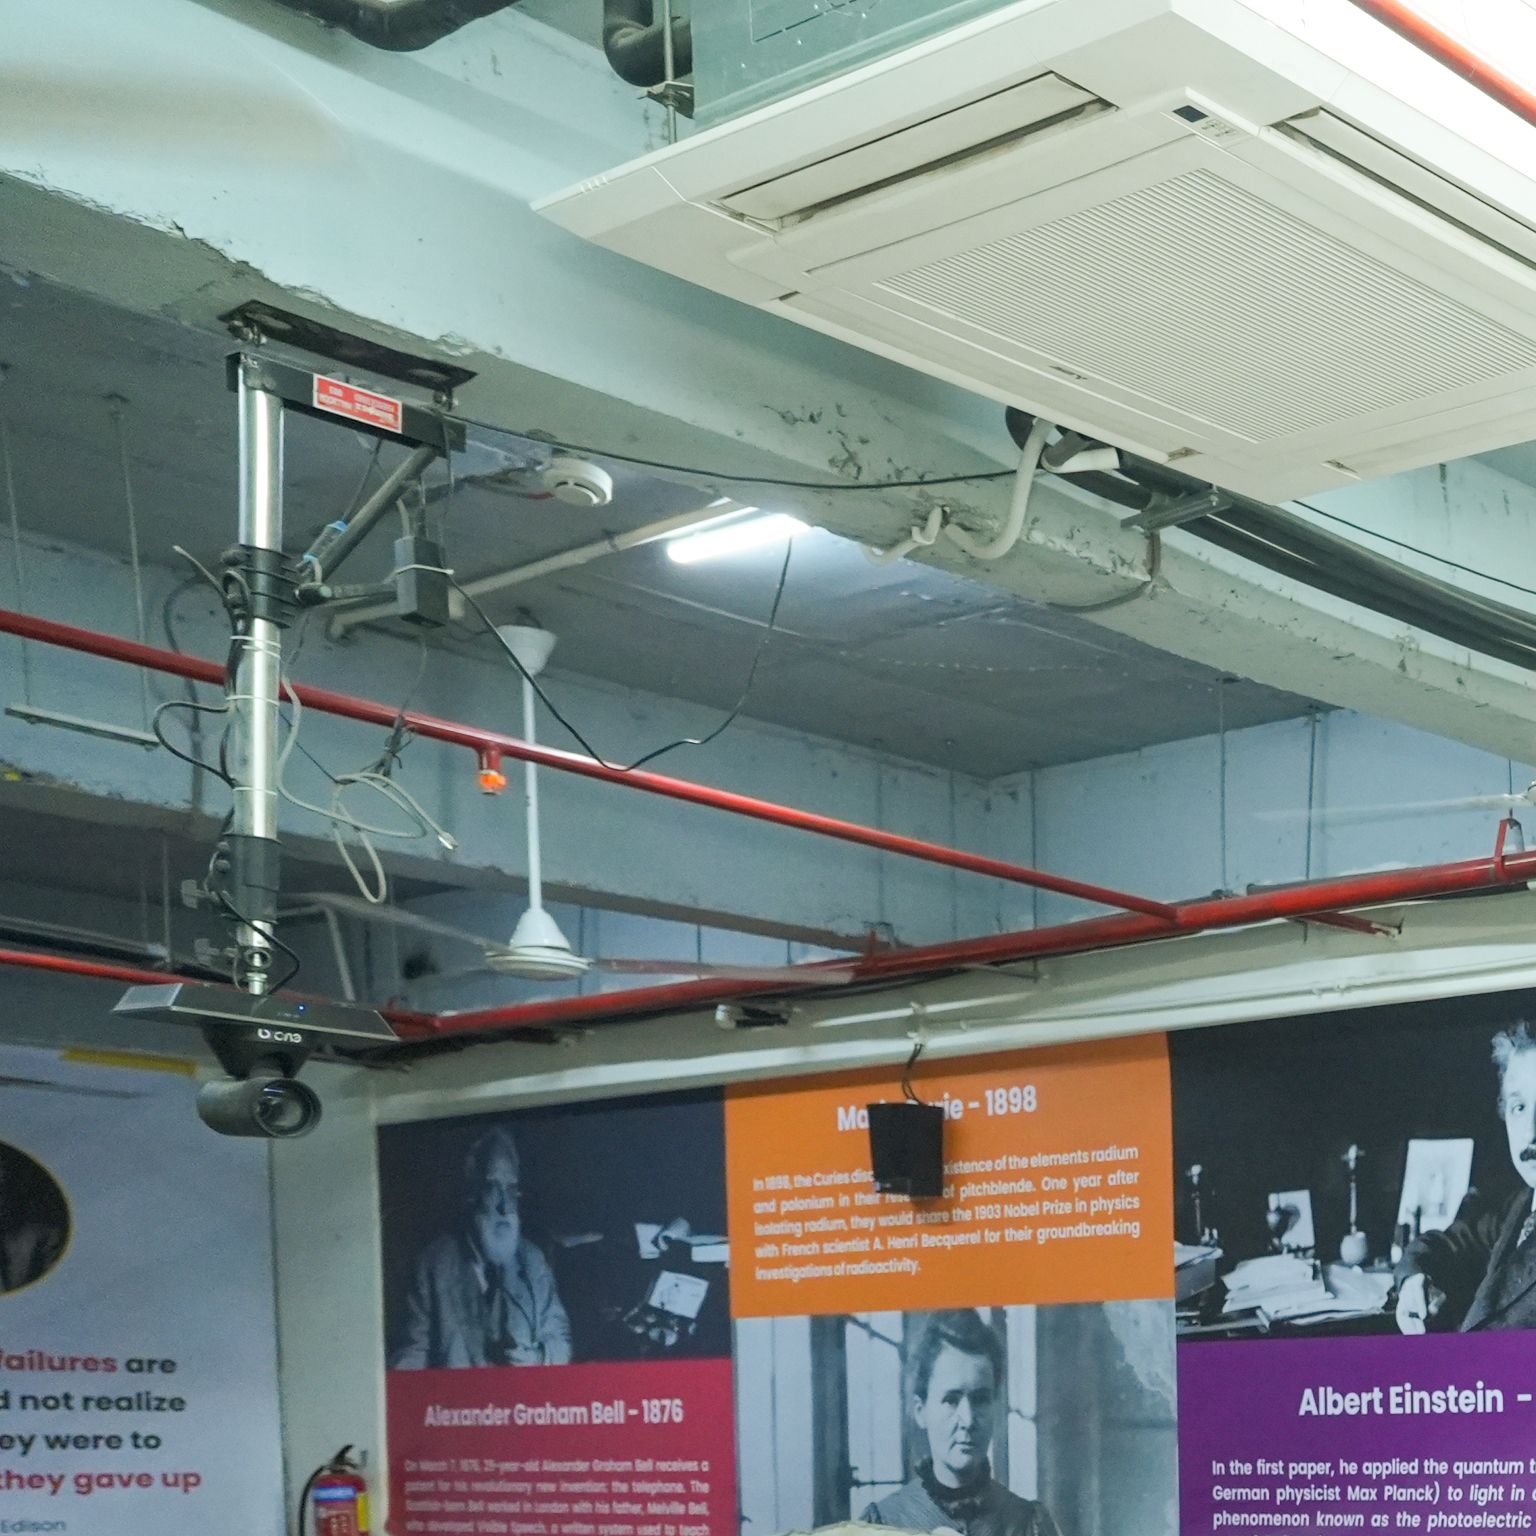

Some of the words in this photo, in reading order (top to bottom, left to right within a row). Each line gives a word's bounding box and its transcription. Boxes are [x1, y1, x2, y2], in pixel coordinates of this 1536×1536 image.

[984, 1084, 1037, 1116] 1898
[944, 1159, 992, 1176] xistence
[994, 1155, 1006, 1171] of
[1008, 1154, 1028, 1170] the
[1030, 1149, 1089, 1168] elements
[1091, 1145, 1139, 1163] radium
[813, 1171, 850, 1187] Curies
[959, 1178, 1036, 1201] pitchblende.
[1041, 1175, 1068, 1191] One
[1072, 1173, 1102, 1193] year
[1107, 1169, 1140, 1187] after
[754, 1199, 776, 1214] and
[780, 1196, 834, 1215] polonium
[839, 1193, 850, 1207] in
[850, 1214, 876, 1231] they
[878, 1210, 913, 1226] would
[952, 1207, 972, 1222] the
[974, 1204, 1001, 1220] 1903
[1003, 1201, 1040, 1218] Nobel
[1042, 1199, 1073, 1215] Prize
[1075, 1197, 1087, 1212] in
[1090, 1193, 1140, 1217] physics
[782, 1240, 820, 1256] French
[822, 1238, 870, 1254] scientist
[887, 1233, 918, 1249] Henri
[921, 1229, 981, 1250] Becquerel
[984, 1228, 1001, 1243] for
[1004, 1225, 1032, 1242] their
[1036, 1218, 1141, 1245] groundbreaking
[125, 1357, 177, 1374] are
[19, 1391, 74, 1412] not
[82, 1390, 187, 1412] realize
[1298, 1385, 1384, 1416] Albert
[1389, 1380, 1504, 1415] Einstein
[424, 1403, 511, 1427] Alexander
[513, 1402, 588, 1426] Graham
[591, 1400, 625, 1425] Bell
[641, 1398, 684, 1424] 1876
[44, 1433, 123, 1450] were
[131, 1431, 162, 1450] to
[1212, 1460, 1226, 1476] In
[1229, 1459, 1252, 1475] the
[1256, 1458, 1284, 1476] first
[1288, 1460, 1335, 1479] paper,
[1339, 1458, 1358, 1475] he
[1362, 1457, 1419, 1480] applied
[1423, 1458, 1449, 1475] the
[1452, 1457, 1524, 1480] quantum
[73, 1472, 154, 1495] gave
[161, 1471, 202, 1494] up
[1212, 1485, 1270, 1501] German
[1276, 1484, 1341, 1506] physicist
[1347, 1485, 1378, 1501] Max
[1383, 1481, 1441, 1505] Planck)
[1447, 1485, 1463, 1501] to
[1469, 1484, 1504, 1506] light
[1510, 1484, 1525, 1501] in
[1213, 1510, 1310, 1530] phenomenon
[1316, 1511, 1364, 1527] known
[1371, 1513, 1389, 1527] as
[1396, 1511, 1421, 1527] the
[1427, 1510, 1532, 1532] photoelectric
